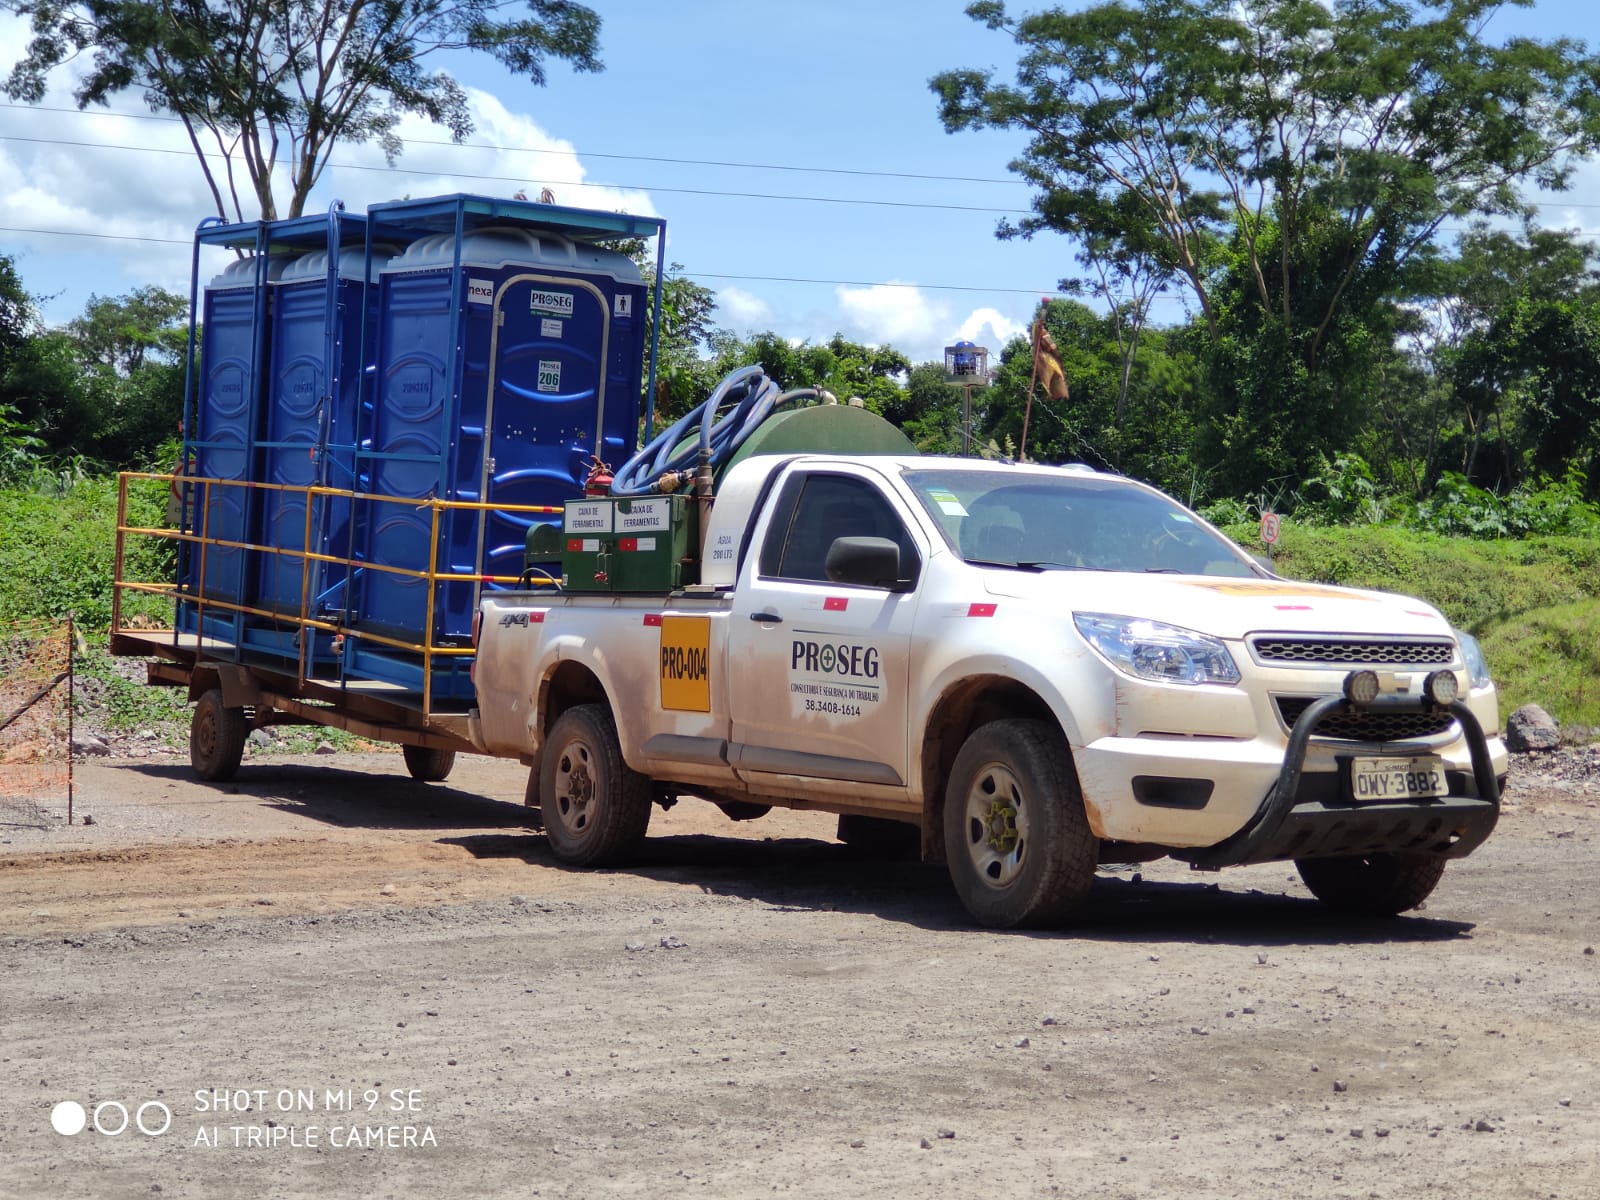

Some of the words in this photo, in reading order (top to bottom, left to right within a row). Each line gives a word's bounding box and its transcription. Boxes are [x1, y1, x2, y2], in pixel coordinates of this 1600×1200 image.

[468, 285, 492, 297] nexa
[532, 292, 572, 308] PROSEG
[539, 372, 559, 386] 206
[578, 507, 591, 516] CAIXA
[592, 507, 598, 515] DE
[646, 504, 653, 514] DE
[572, 519, 604, 528] FERRAMENTAS
[623, 518, 660, 528] FERRAMENTAS
[713, 549, 723, 559] 200
[724, 549, 733, 559] LTS
[662, 646, 707, 681] PRO-004
[791, 640, 879, 678] PROSEG
[790, 683, 819, 695] CONSULTORIA
[823, 686, 848, 699] SEGURANÇA
[848, 689, 855, 699] DO
[856, 690, 879, 702] TRABALHO
[805, 699, 861, 716] 38.3408-1614
